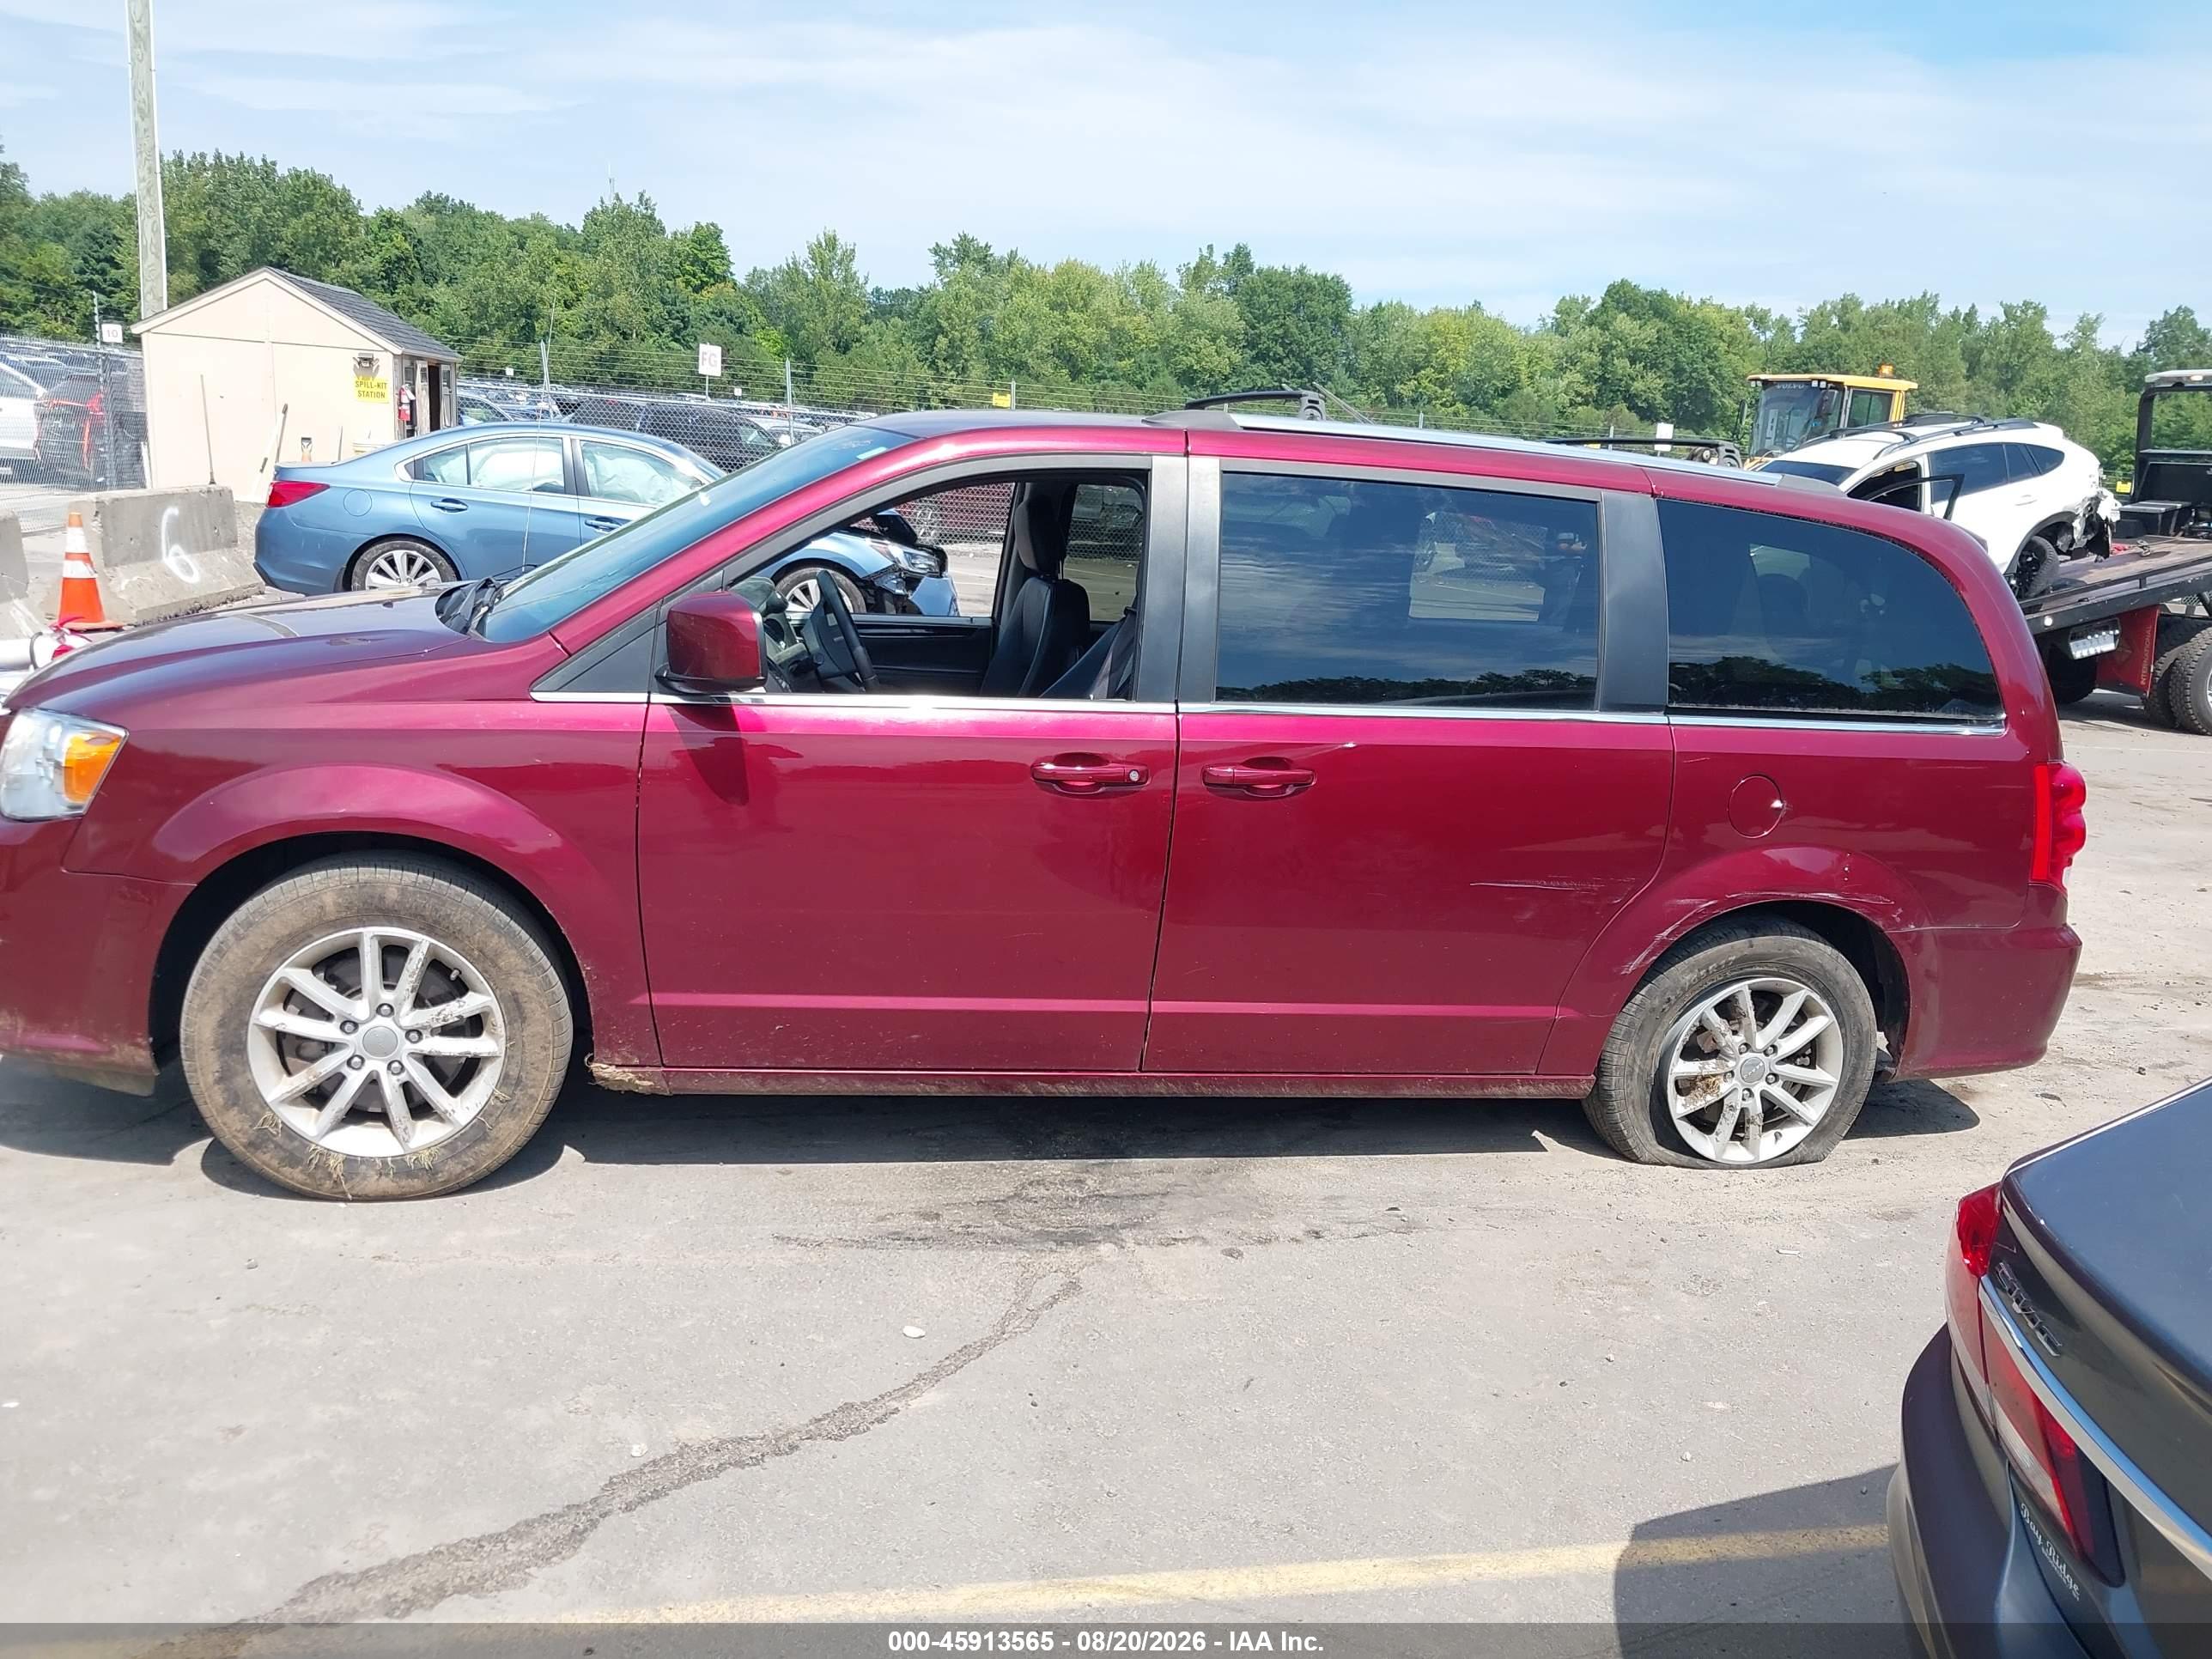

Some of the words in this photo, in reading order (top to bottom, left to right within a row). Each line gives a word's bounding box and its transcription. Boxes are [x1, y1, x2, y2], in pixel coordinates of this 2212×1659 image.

[106, 329, 118, 338] 10
[701, 350, 718, 368] FG
[355, 380, 388, 390] SPILL-KIT
[357, 390, 386, 398] STATION
[161, 507, 201, 584] 6
[1995, 1262, 2063, 1357] CIVIC
[2021, 1502, 2043, 1546] Bay
[2045, 1540, 2080, 1596] Ridge
